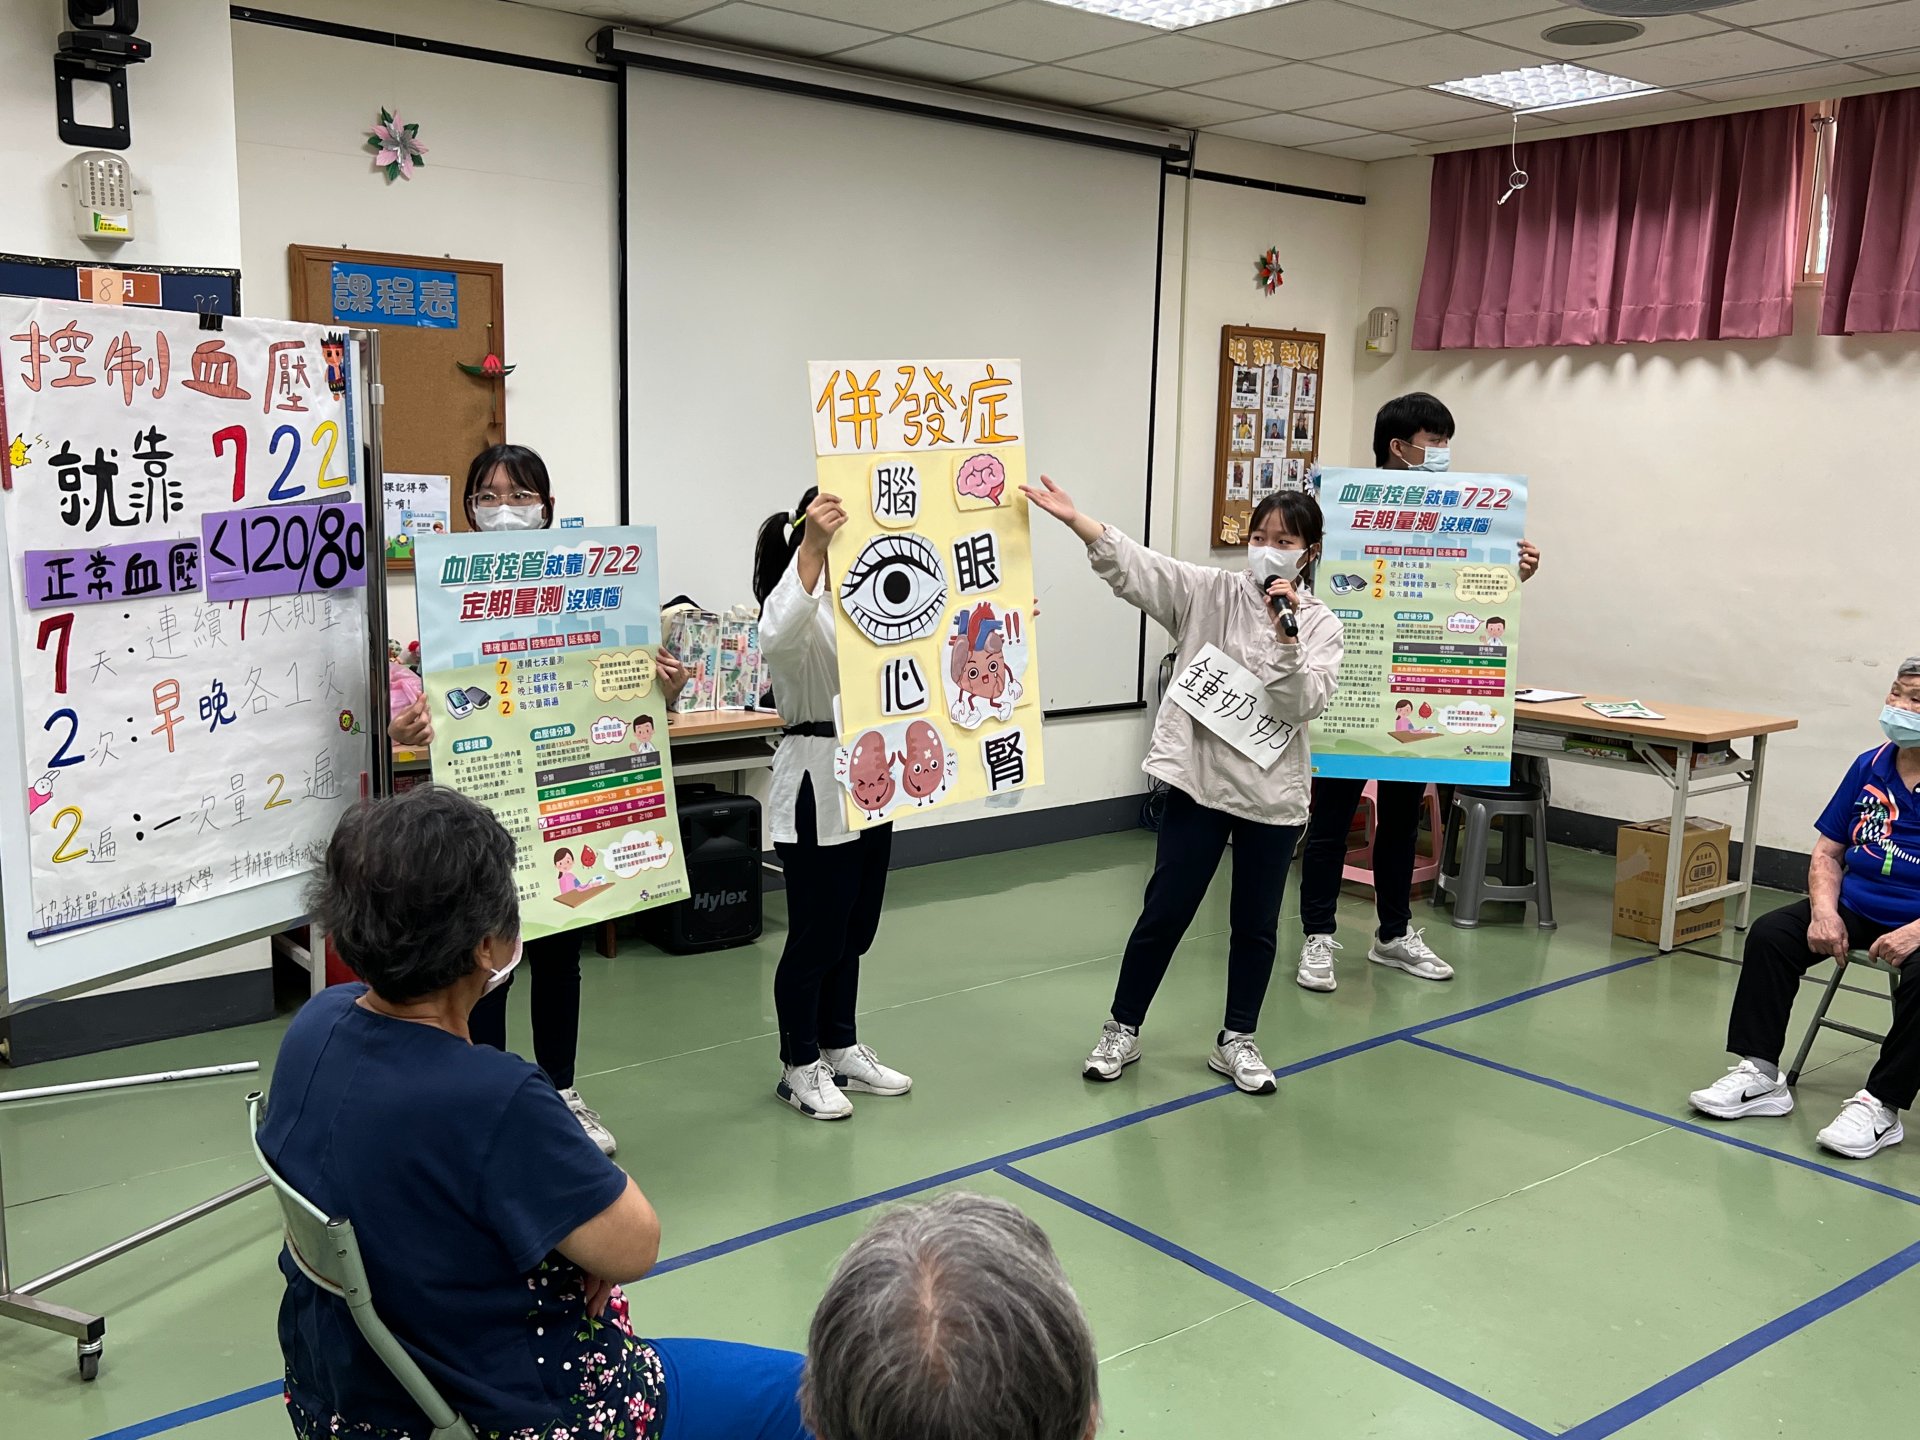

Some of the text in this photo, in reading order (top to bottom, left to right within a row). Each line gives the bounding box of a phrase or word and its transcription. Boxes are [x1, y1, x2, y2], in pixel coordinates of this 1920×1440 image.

[333, 271, 456, 320] 課程表
[10, 319, 312, 415] 控制血壓
[816, 363, 1019, 450] 併發症
[874, 466, 917, 519] 腦
[1338, 483, 1513, 509] 血壓控管就靠722
[1350, 509, 1493, 534] 定期量測 沒煩惱
[41, 506, 366, 602] 正常血壓 <120/80
[440, 545, 642, 585] 血壓控管就靠722
[955, 532, 997, 592] 眼
[1376, 560, 1383, 570] 7
[1374, 588, 1382, 598] 2
[1375, 574, 1383, 583] 2
[460, 585, 623, 621] 定期量測 沒煩惱
[484, 633, 599, 654] 準確量血壓 控制血壓 延長壽命
[499, 656, 565, 675] 7 連續七天量測
[500, 680, 508, 694] 2
[884, 659, 925, 712] 心
[1178, 657, 1293, 749] 鍾奶奶
[502, 701, 511, 714] 2
[985, 729, 1024, 791] 腎
[693, 889, 748, 912] Hylex
